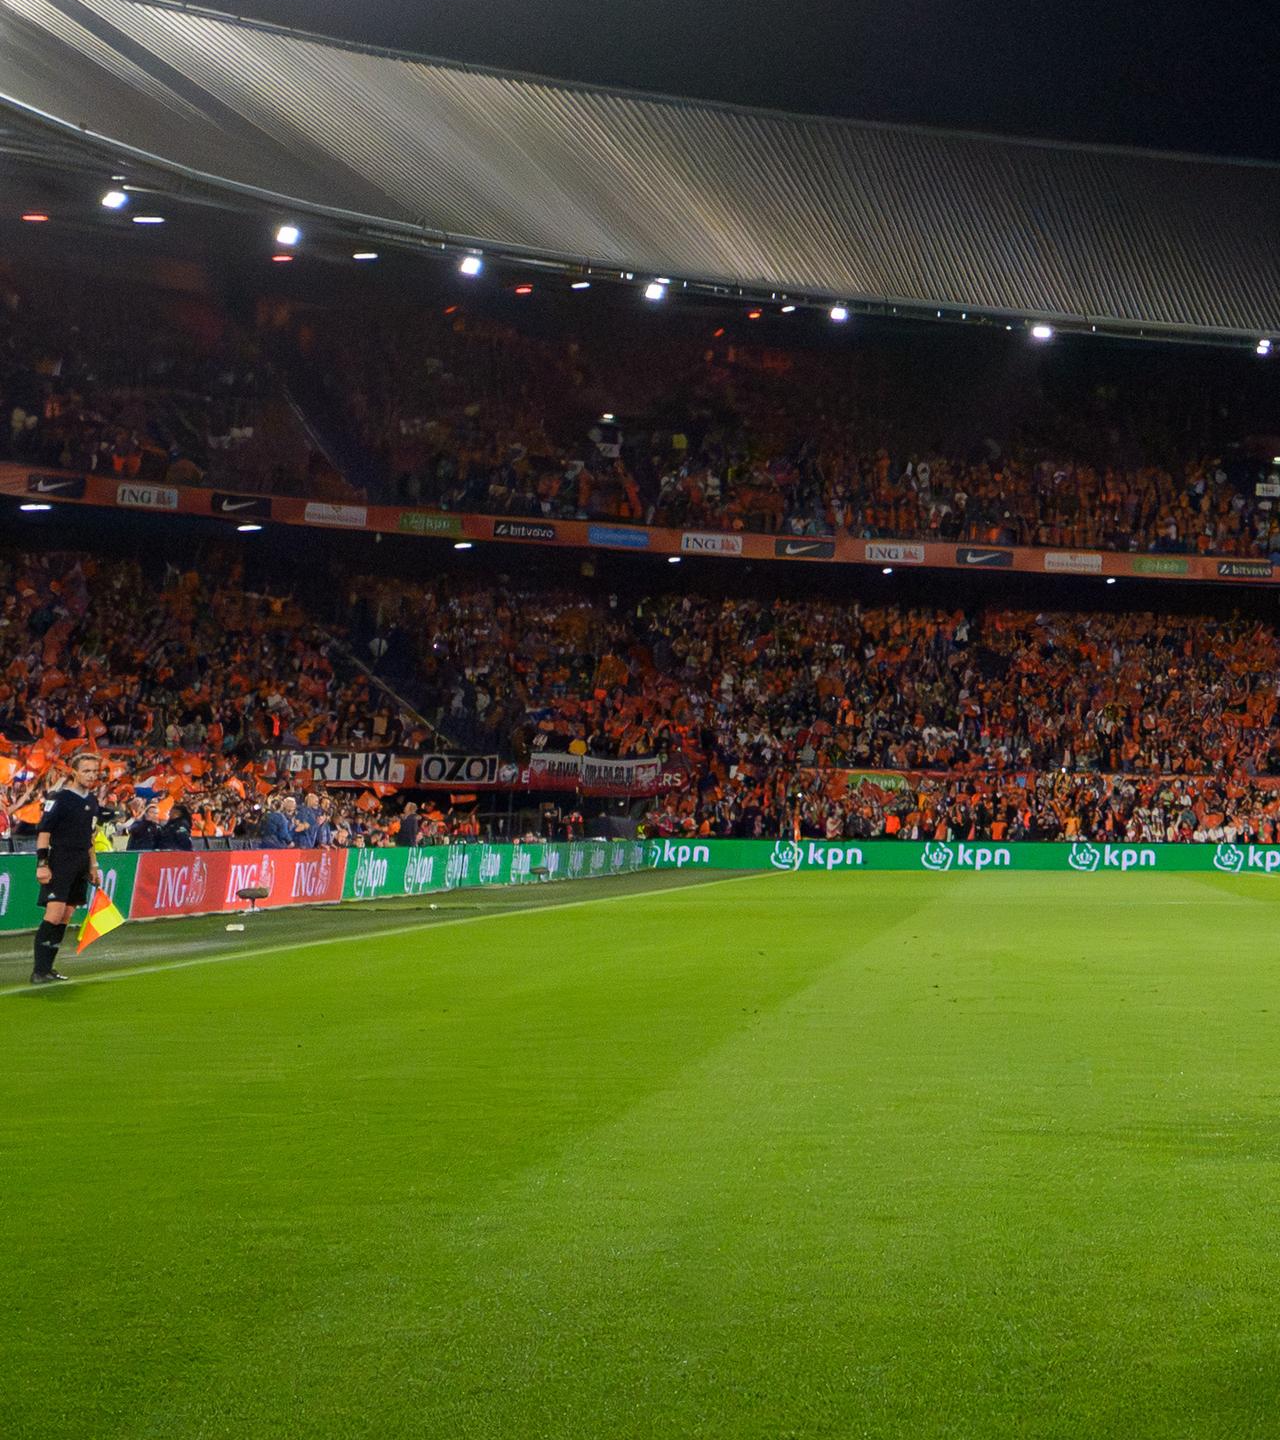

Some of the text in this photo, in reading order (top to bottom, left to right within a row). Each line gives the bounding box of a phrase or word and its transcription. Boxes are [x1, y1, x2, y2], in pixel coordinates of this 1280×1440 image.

[120, 488, 151, 504] ING
[510, 525, 555, 540] bitvavo
[685, 536, 716, 550] ING
[868, 545, 899, 560] ING
[1231, 565, 1272, 577] bitvavo
[303, 752, 391, 782] RTUM
[664, 840, 710, 867] kpn
[808, 843, 863, 870] kpn
[958, 844, 1010, 870] kpn
[1104, 845, 1155, 870] kpn
[292, 861, 321, 898] ING
[366, 849, 388, 896] kpn
[415, 847, 433, 892] kpn
[155, 867, 190, 909] ING
